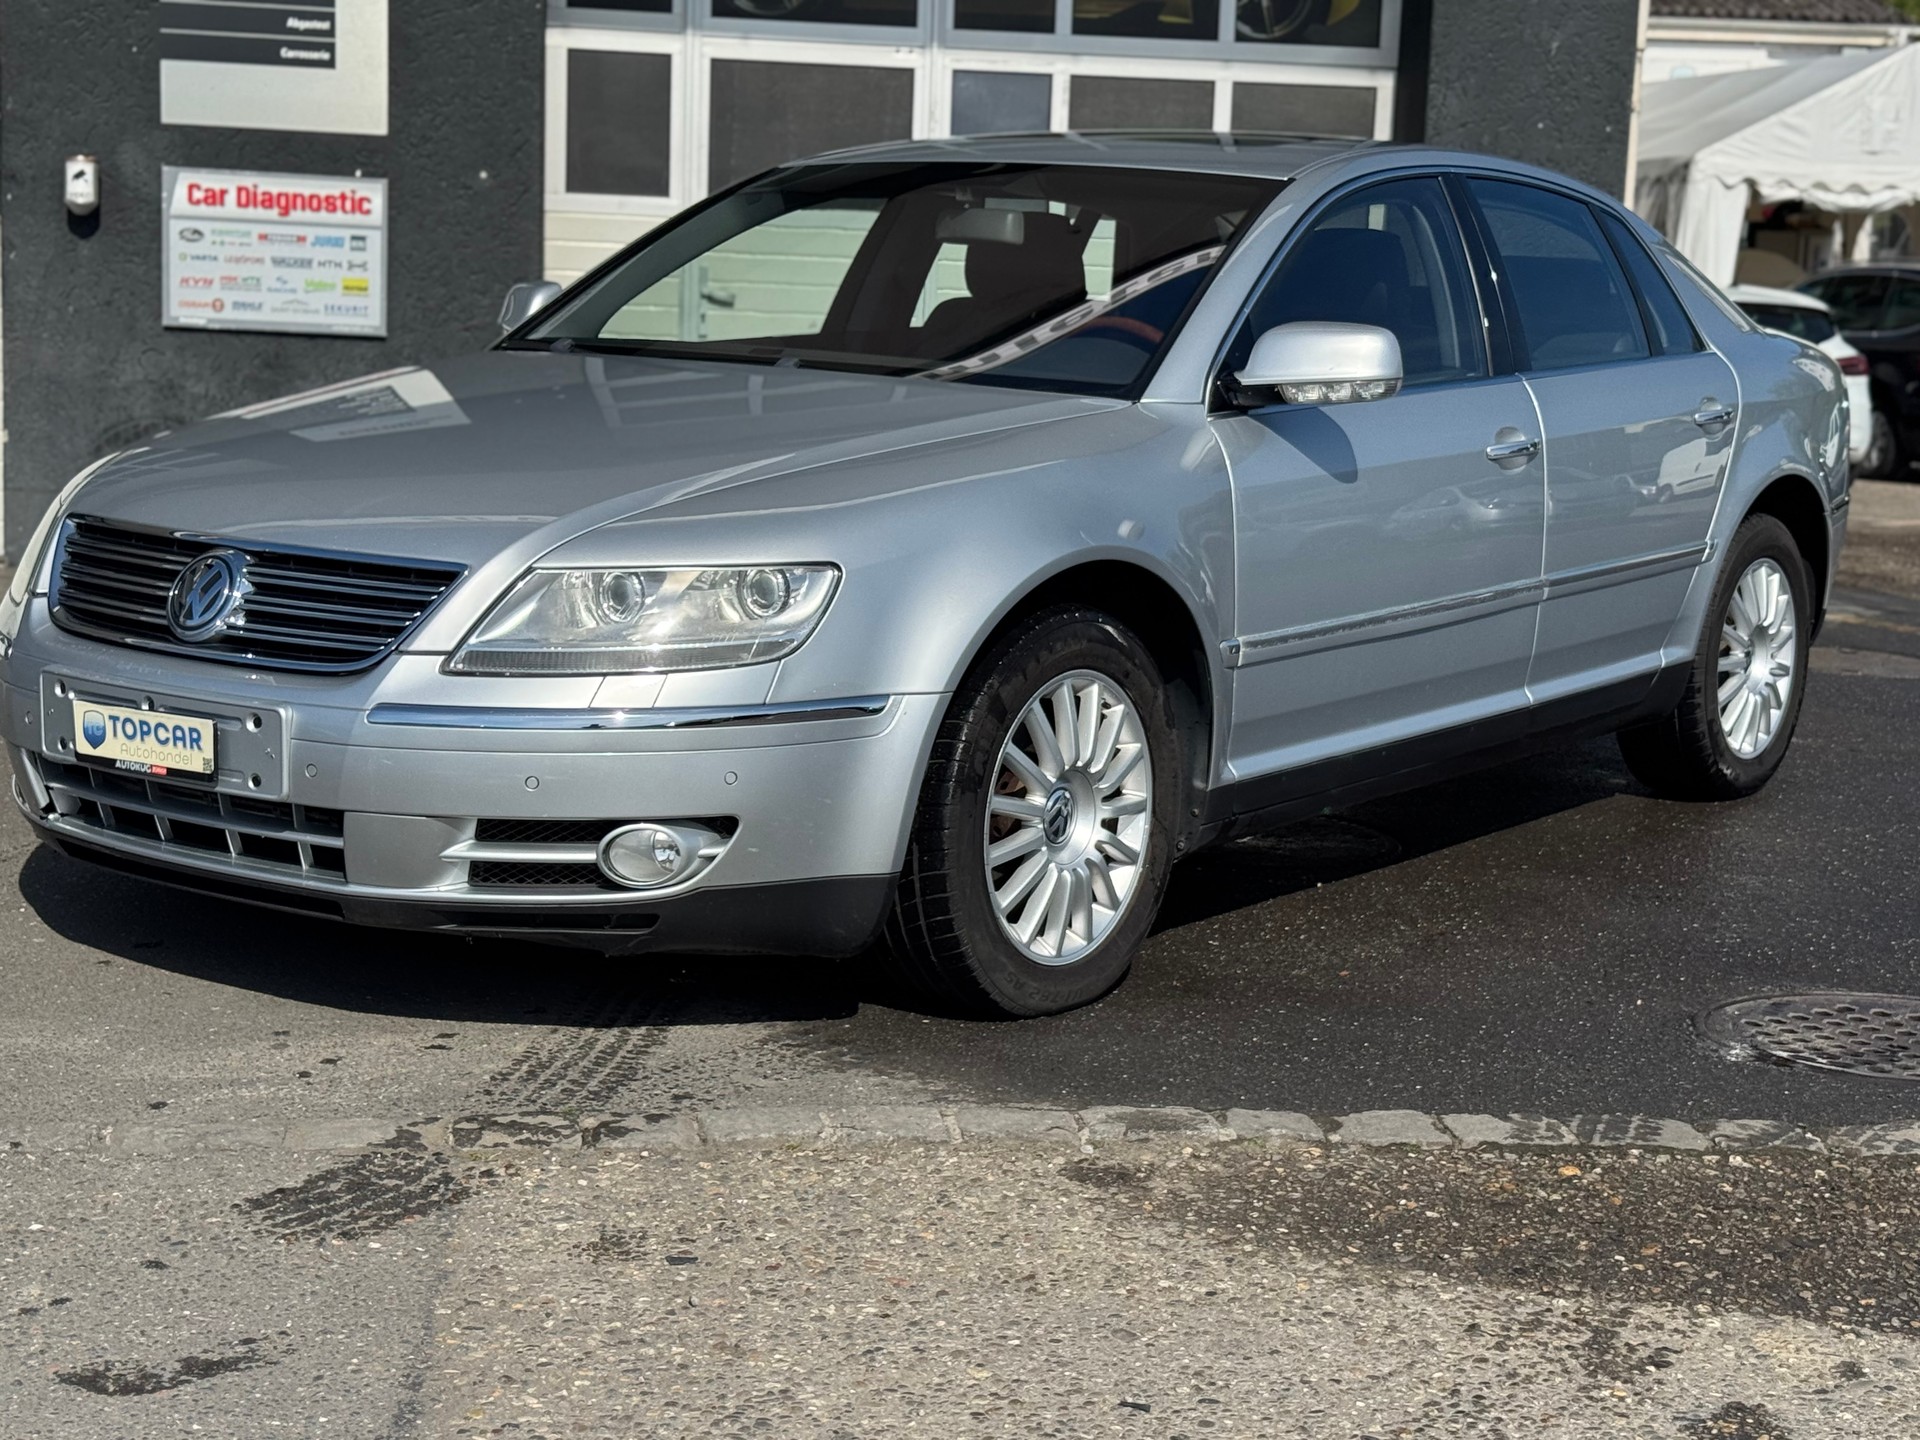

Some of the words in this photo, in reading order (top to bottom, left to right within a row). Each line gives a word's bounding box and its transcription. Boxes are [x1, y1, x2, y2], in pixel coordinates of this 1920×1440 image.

[187, 183, 228, 207] Car
[236, 184, 372, 217] Diagnostic
[108, 714, 203, 751] TOPCAR
[120, 742, 193, 765] Autohandel
